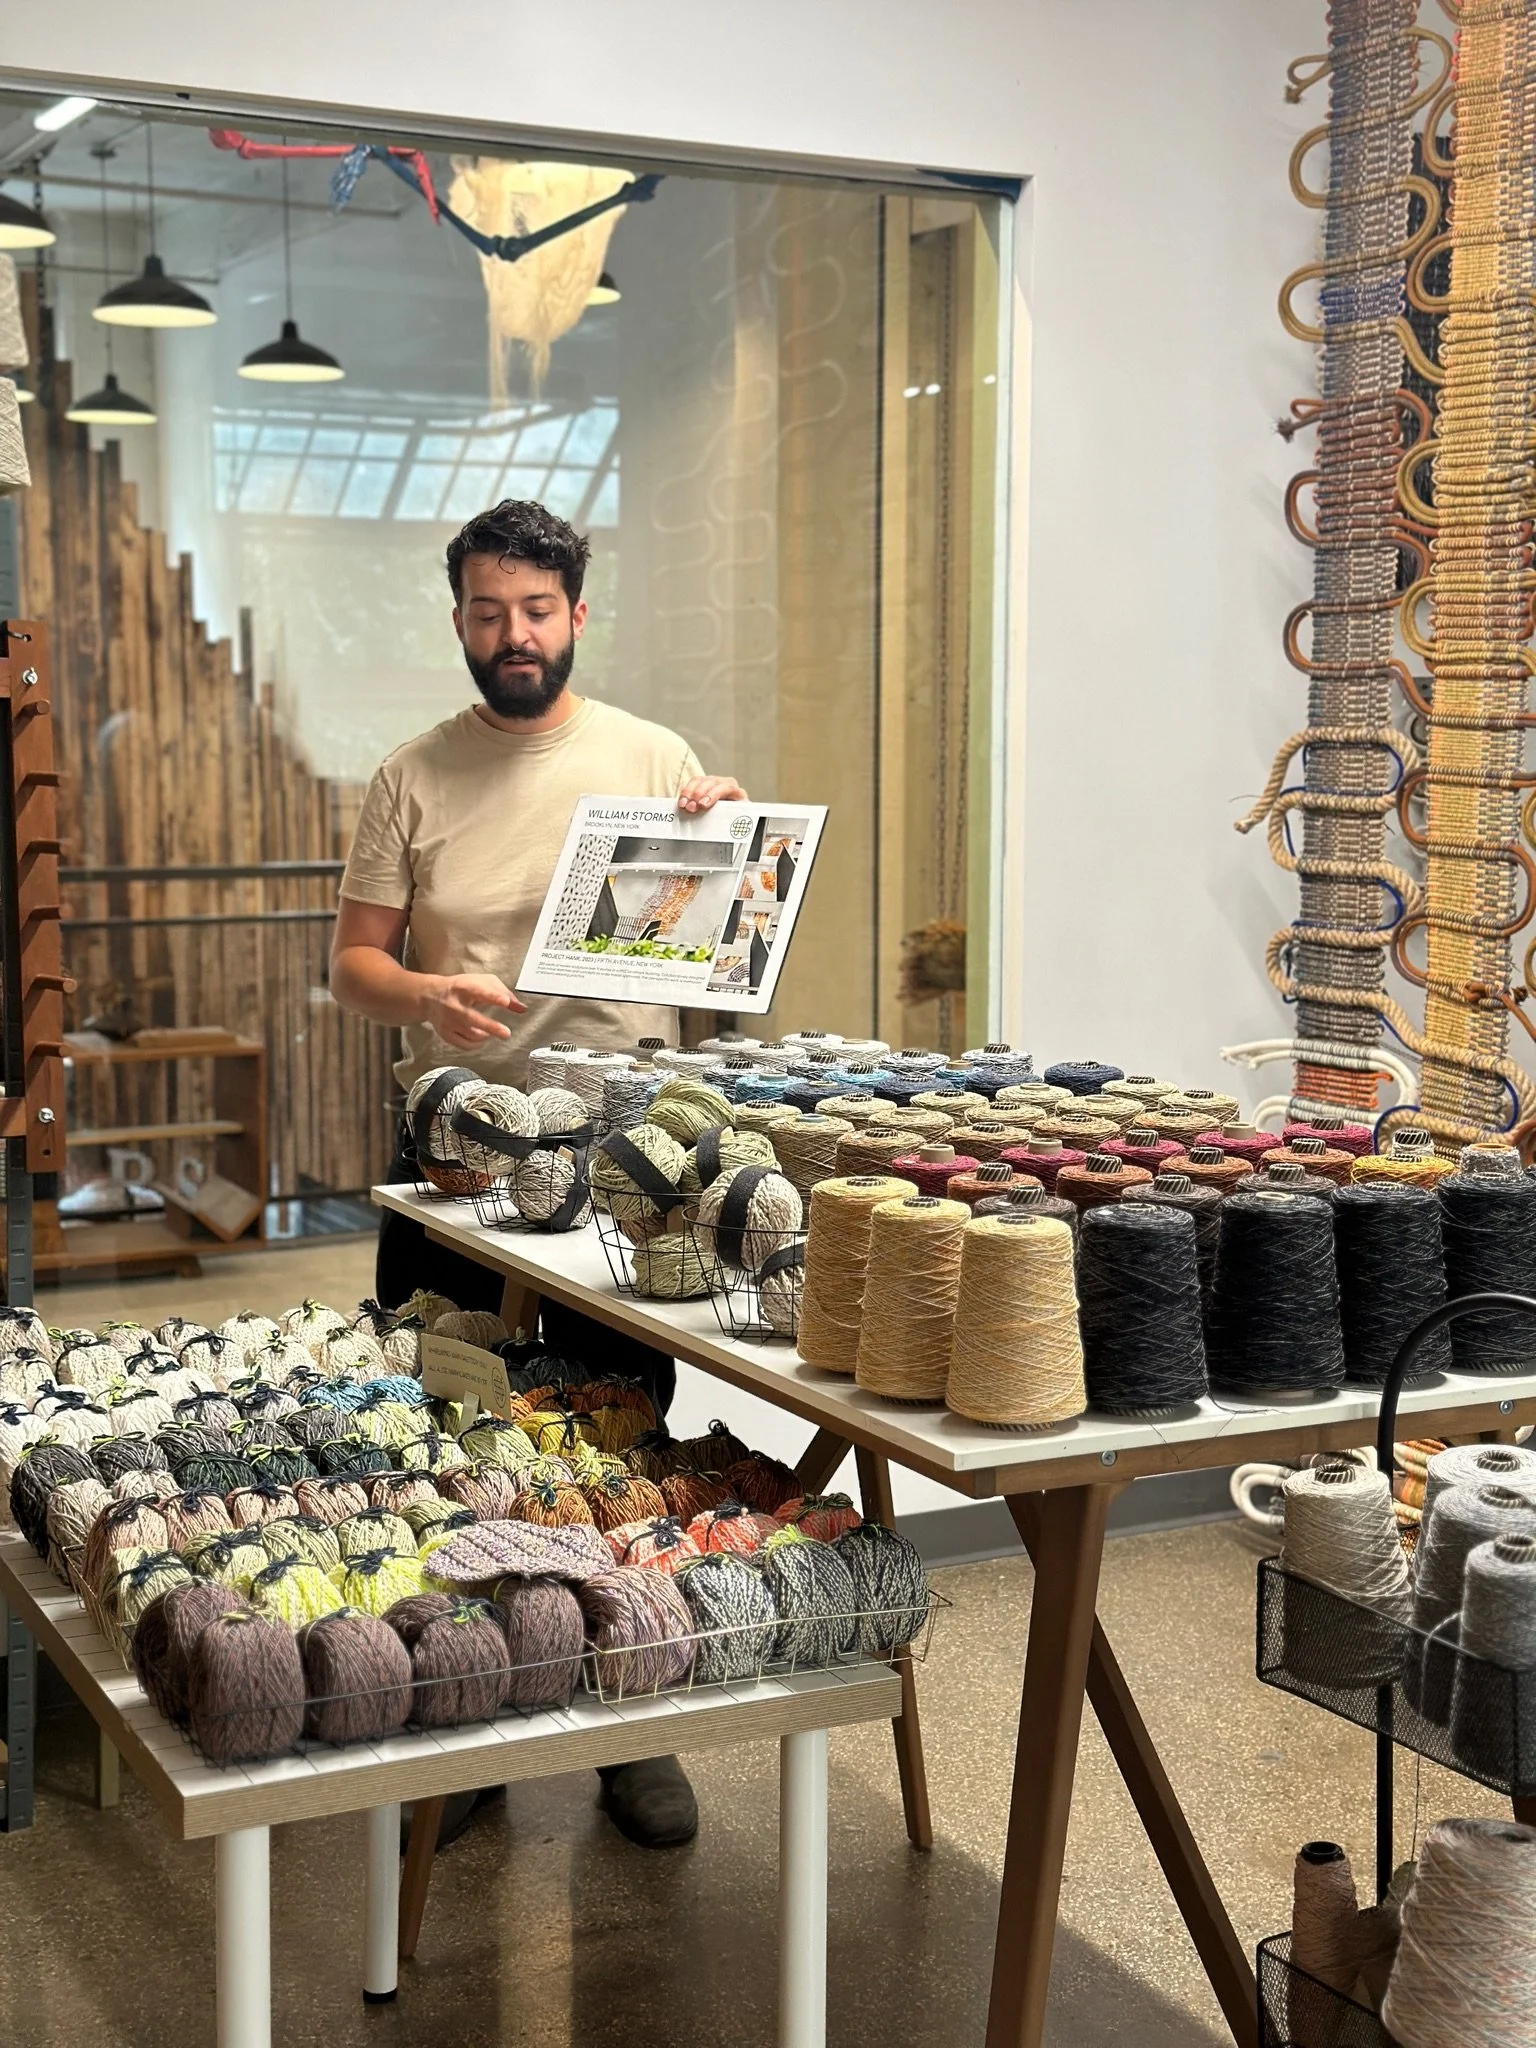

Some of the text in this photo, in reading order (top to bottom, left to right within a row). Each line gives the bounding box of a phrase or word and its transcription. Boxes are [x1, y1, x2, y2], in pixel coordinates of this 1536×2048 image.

[588, 809, 675, 822] WILLIAM STORMS
[541, 952, 565, 960] PROJECT
[597, 957, 613, 965] FIFTH
